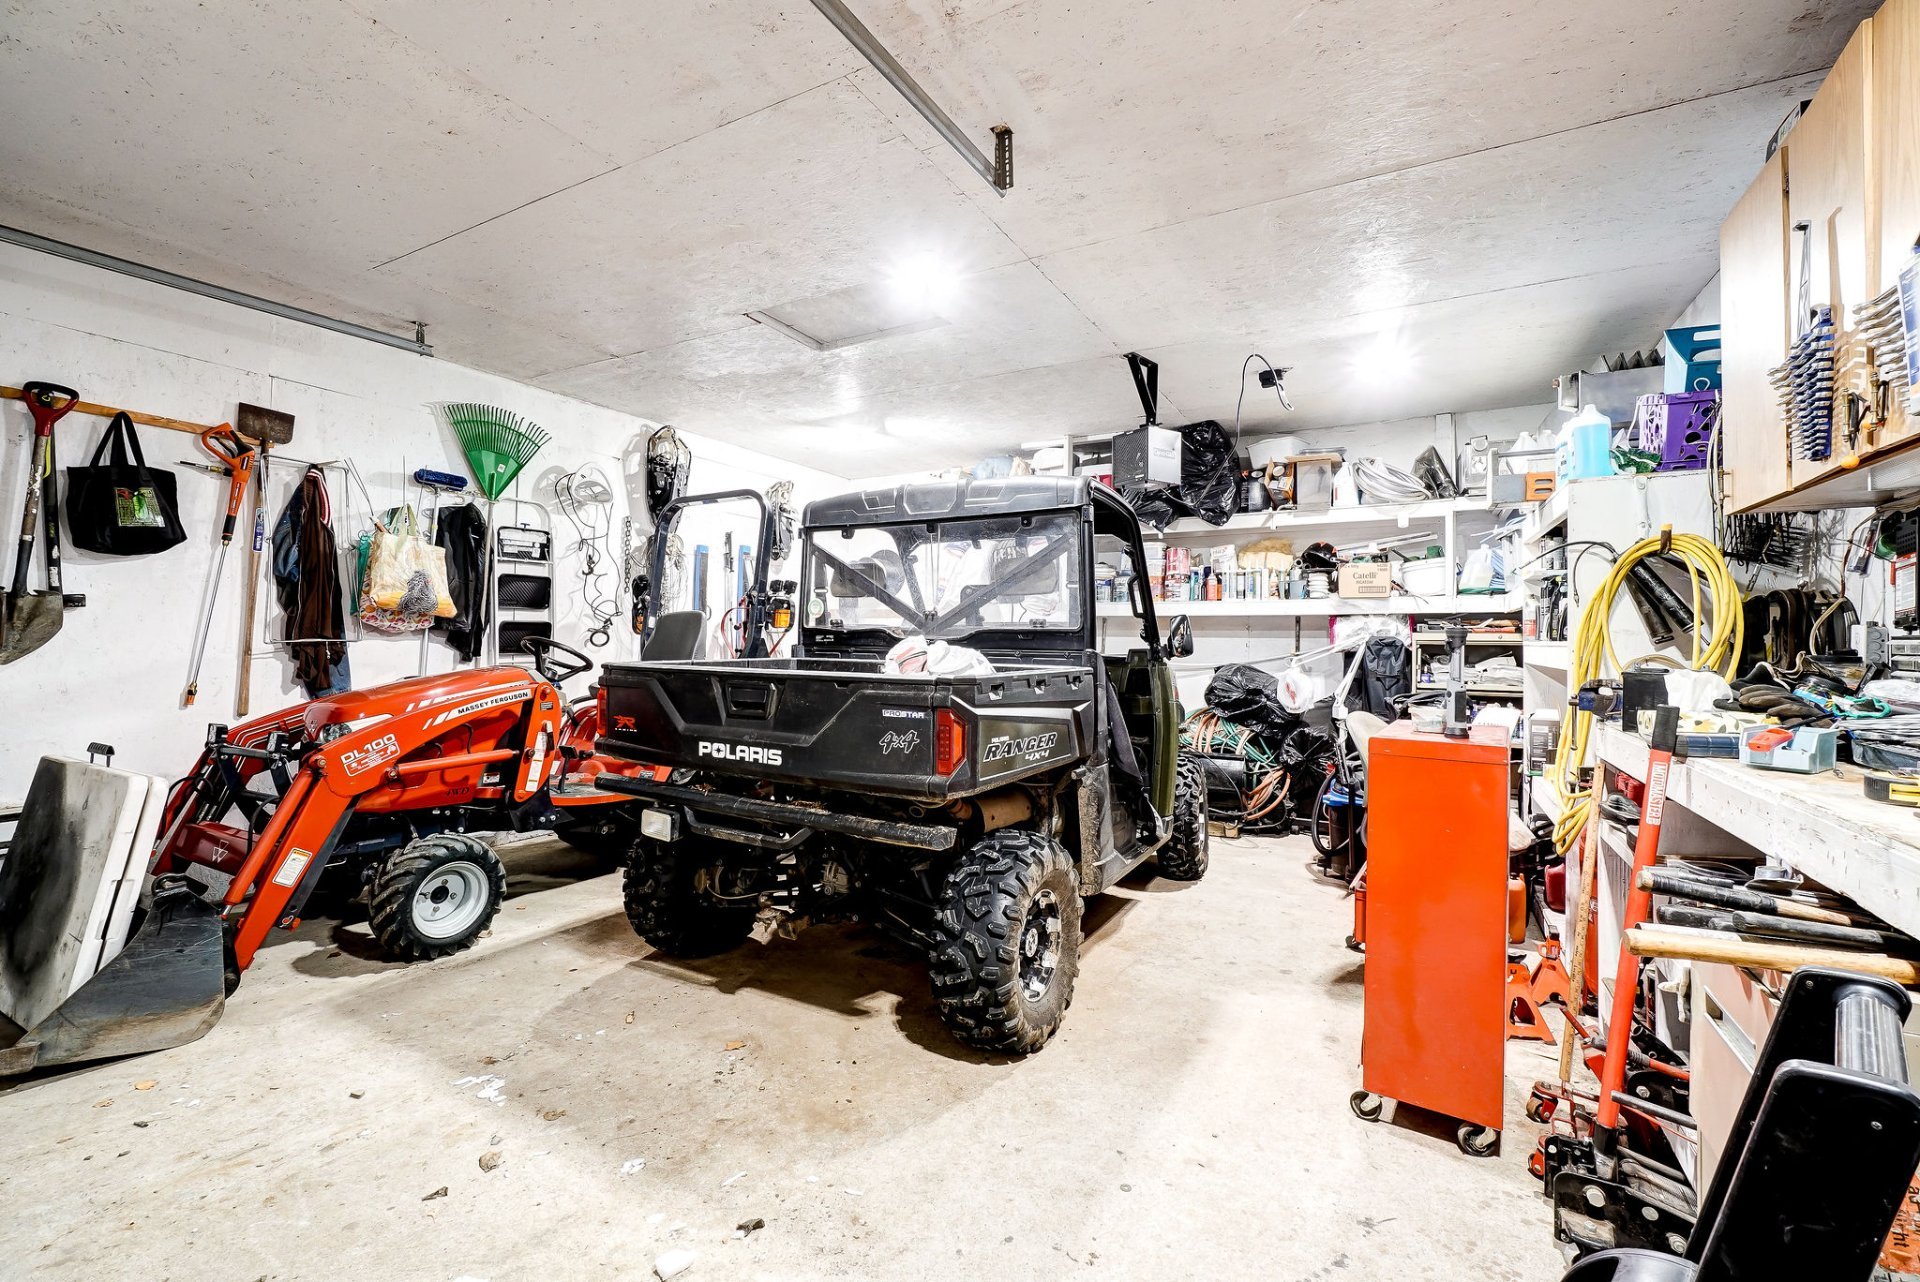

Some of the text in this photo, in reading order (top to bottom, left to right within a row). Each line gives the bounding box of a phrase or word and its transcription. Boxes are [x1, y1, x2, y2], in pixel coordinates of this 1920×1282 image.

[1353, 571, 1377, 579] Catelli
[457, 691, 528, 715] MASSEY FERGUSON
[882, 709, 925, 719] PROSTAR
[698, 741, 783, 766] POLARIS
[983, 732, 1058, 762] RANGER
[1648, 762, 1666, 821] MOTOMASTER
